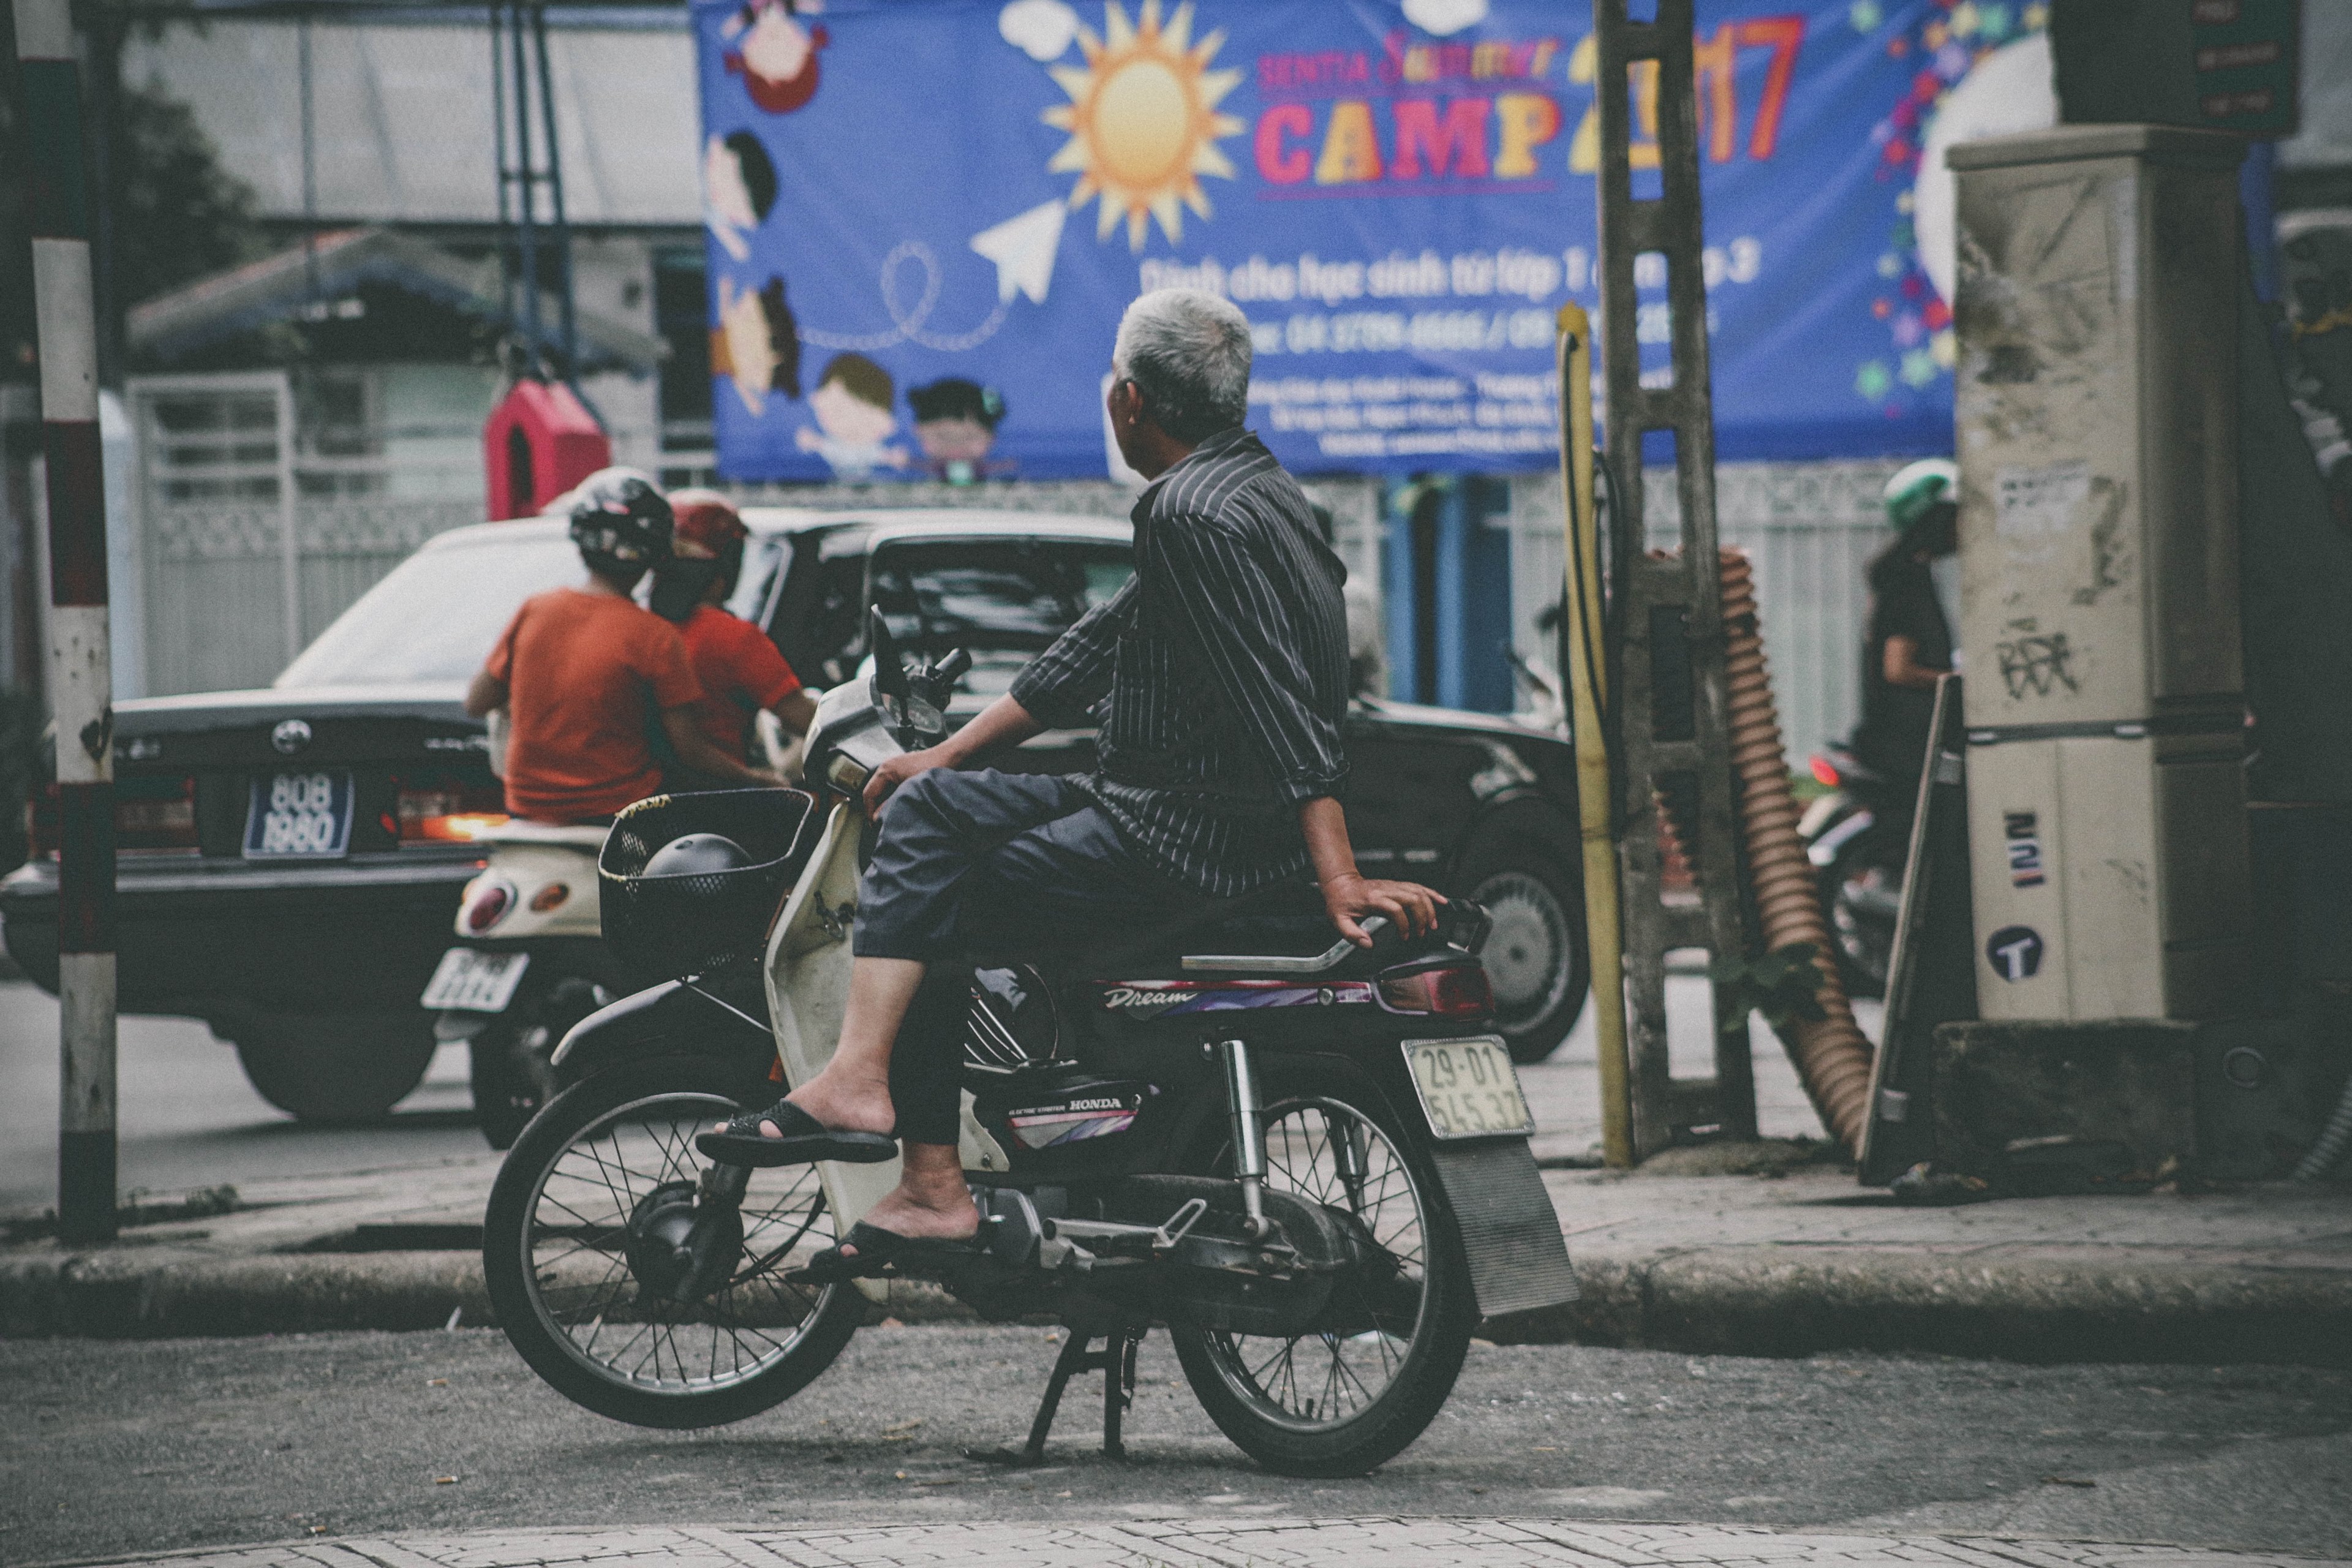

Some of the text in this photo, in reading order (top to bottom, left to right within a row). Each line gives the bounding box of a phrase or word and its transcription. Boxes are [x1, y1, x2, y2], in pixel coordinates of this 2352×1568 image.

[1254, 93, 1562, 185] CAMP
[1104, 987, 1199, 1008] Dream
[1069, 1098, 1122, 1111] HONDA
